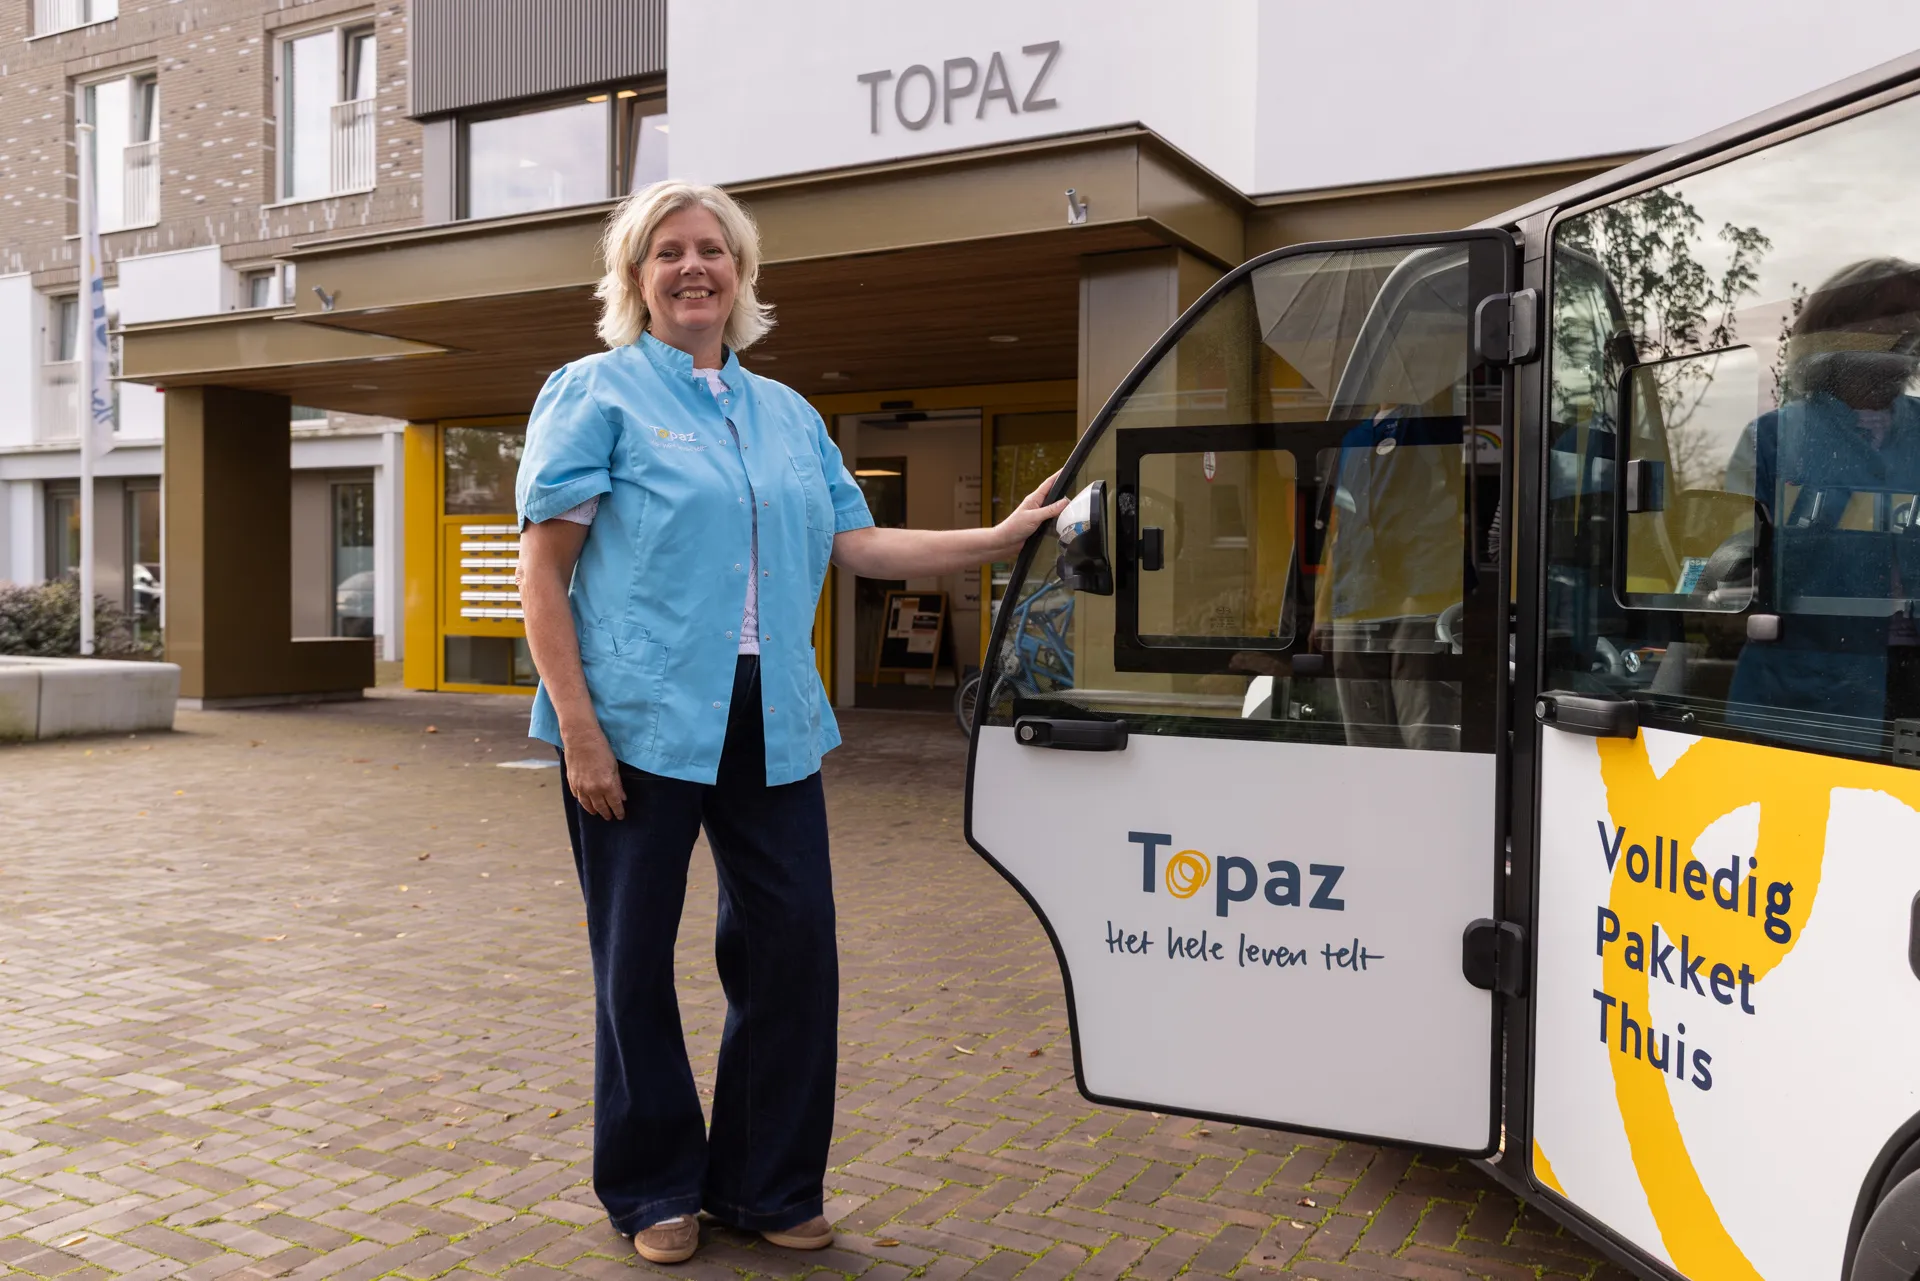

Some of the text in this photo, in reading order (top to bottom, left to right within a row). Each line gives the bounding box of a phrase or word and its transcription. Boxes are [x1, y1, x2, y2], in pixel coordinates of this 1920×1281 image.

[857, 40, 1060, 134] TOPAZ
[648, 425, 697, 442] Topaz
[1128, 831, 1345, 918] Topaz
[1597, 820, 1793, 944] Volledig
[1105, 920, 1385, 972] Het hele leven telt
[1597, 905, 1755, 1015] Pakket
[1593, 988, 1713, 1091] Thuis
